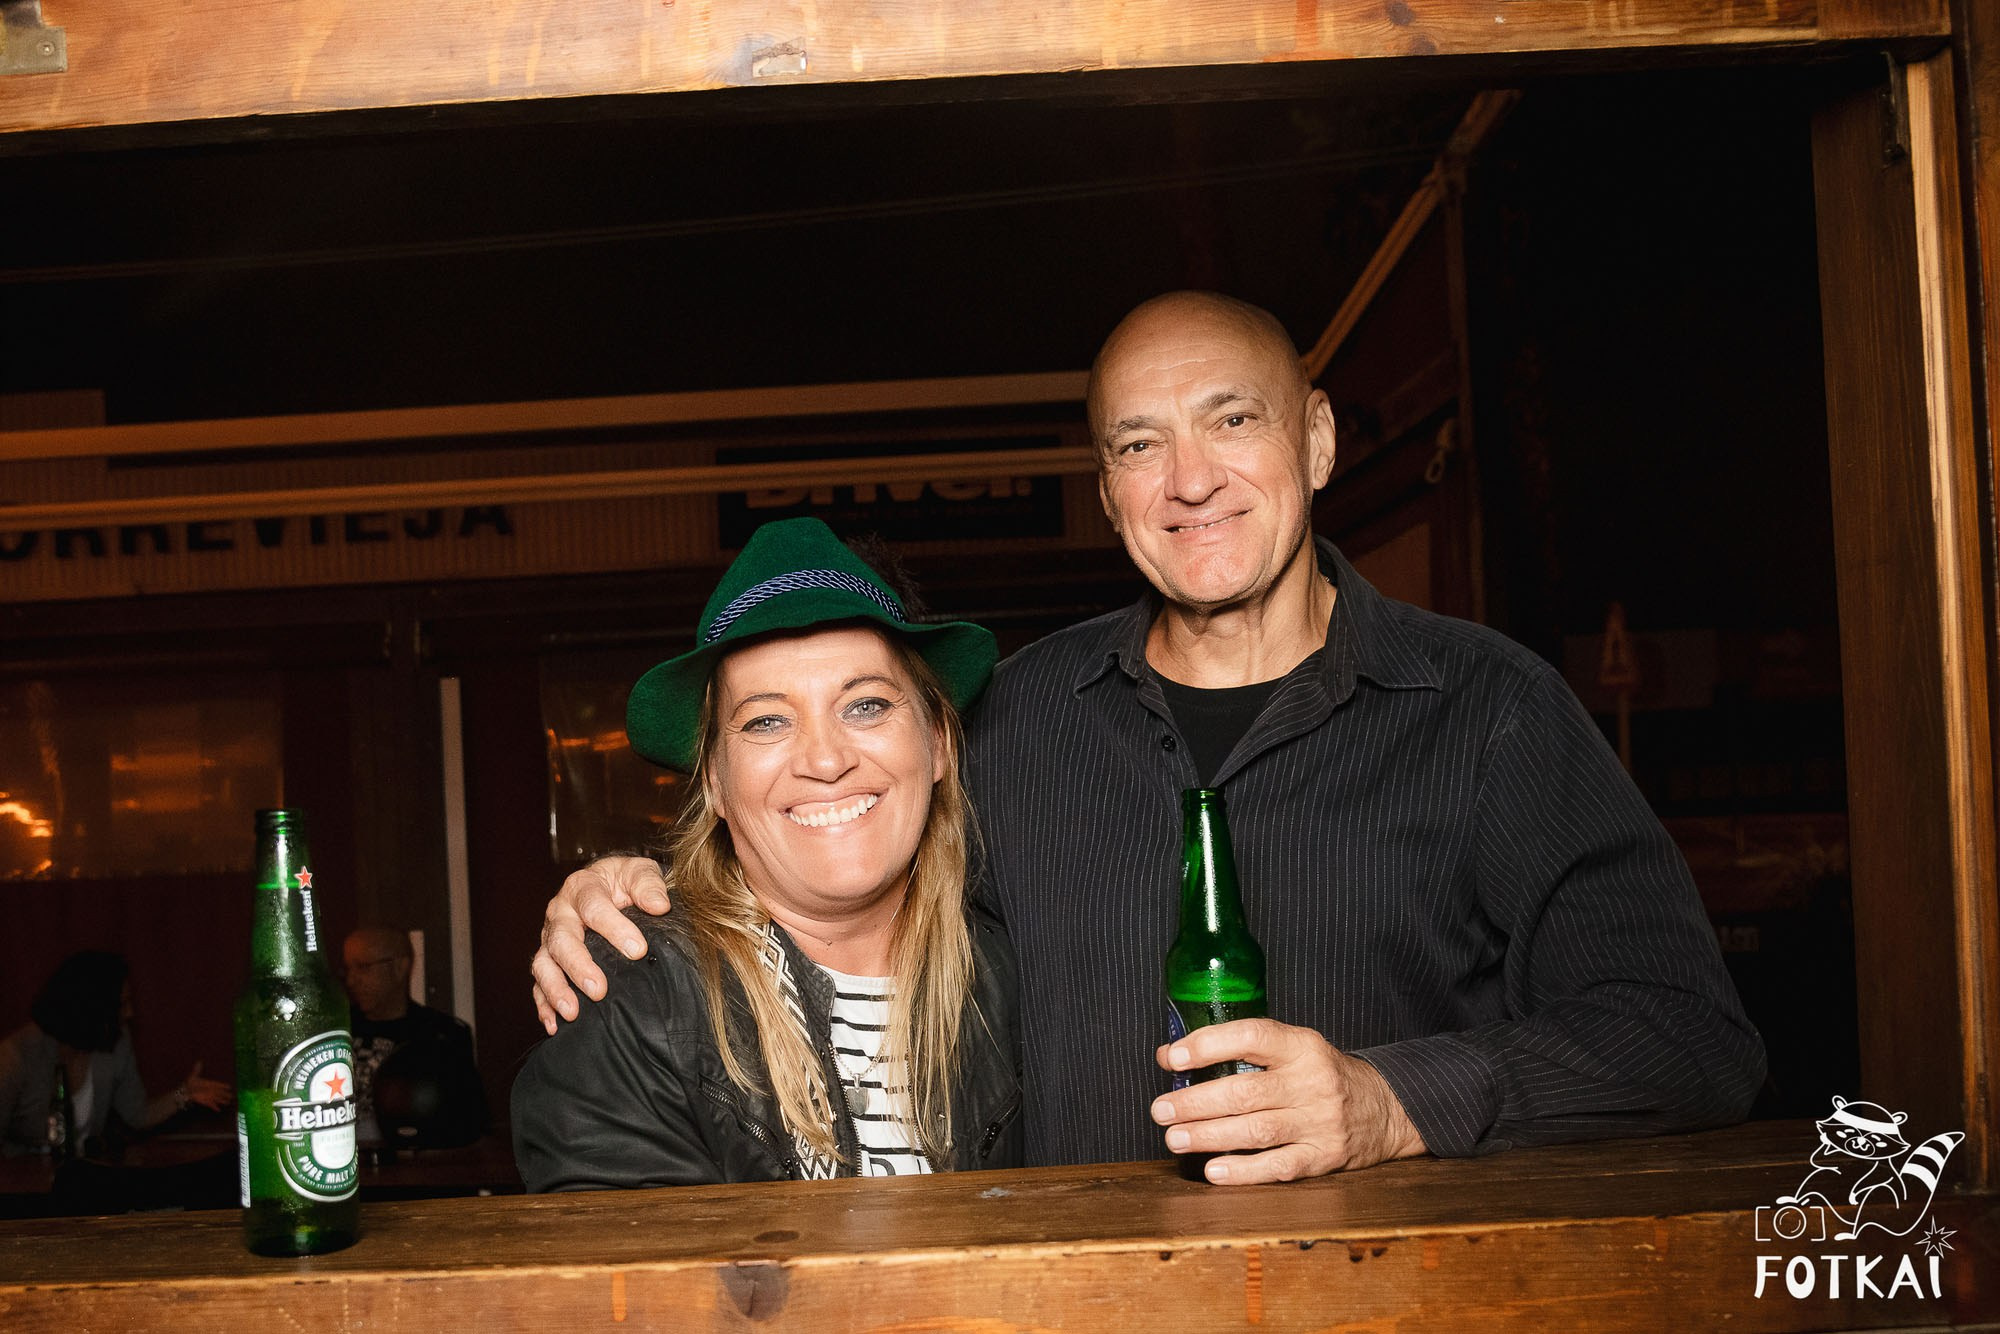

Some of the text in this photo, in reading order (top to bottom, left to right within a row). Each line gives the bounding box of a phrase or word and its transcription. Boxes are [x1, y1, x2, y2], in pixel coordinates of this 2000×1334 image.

[301, 890, 318, 951] Heineken
[294, 1049, 335, 1090] HEINEKEN
[298, 1155, 323, 1182] PURE
[325, 1170, 349, 1184] MALT
